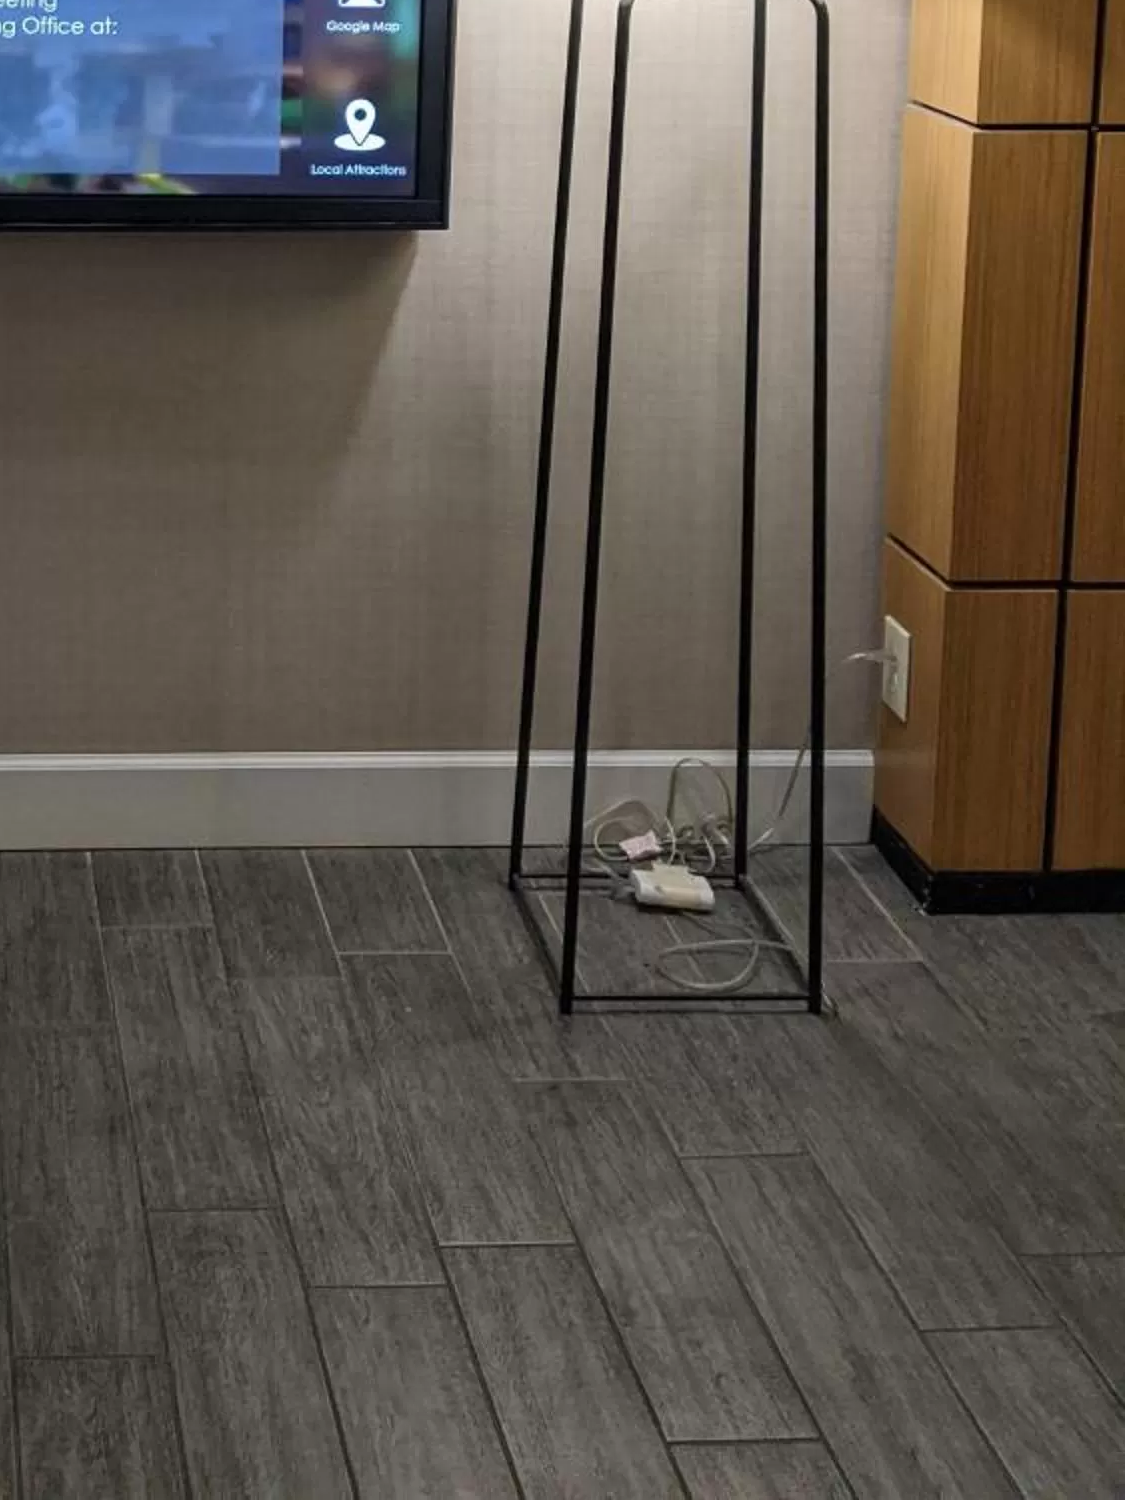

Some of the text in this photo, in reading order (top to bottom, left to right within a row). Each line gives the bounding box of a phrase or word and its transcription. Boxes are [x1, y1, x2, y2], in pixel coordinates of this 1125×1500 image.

[22, 16, 84, 35] Office
[90, 16, 118, 35] at:
[326, 20, 401, 34] Google Map
[311, 163, 407, 176] Local Attractions
